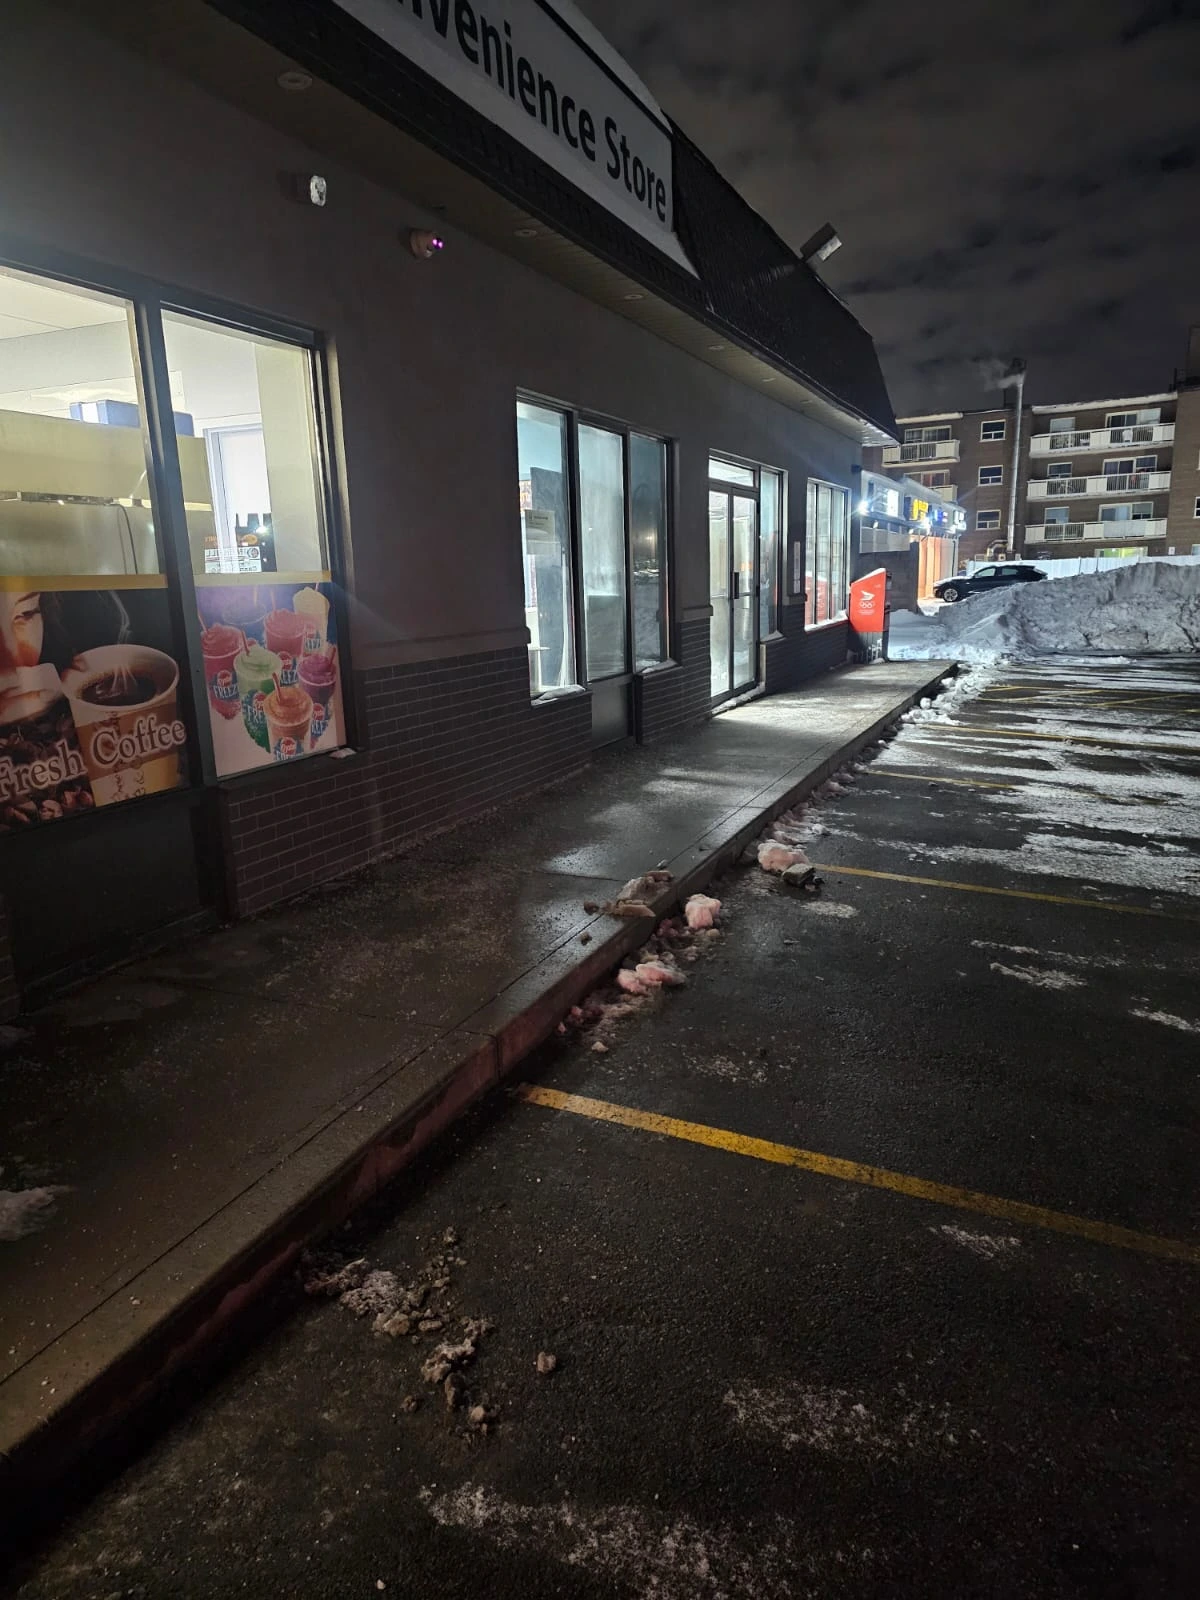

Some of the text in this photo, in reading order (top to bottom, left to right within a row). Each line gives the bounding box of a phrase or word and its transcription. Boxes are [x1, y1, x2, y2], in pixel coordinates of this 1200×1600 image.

[398, 0, 666, 222] venience Store
[0, 716, 186, 797] Fresh Coffee
